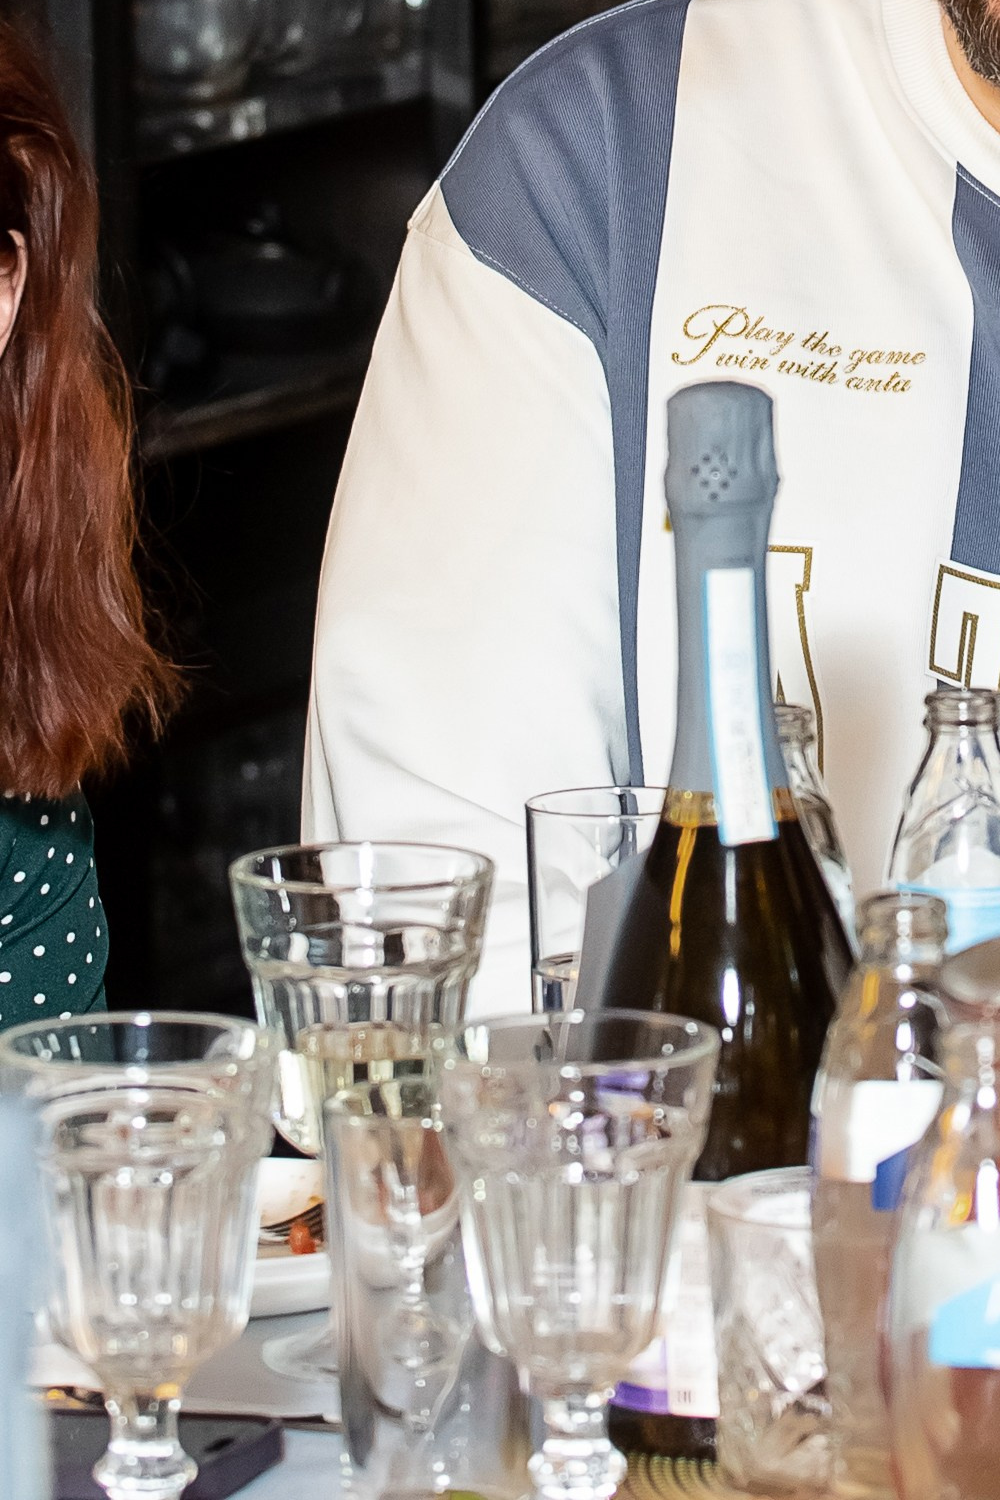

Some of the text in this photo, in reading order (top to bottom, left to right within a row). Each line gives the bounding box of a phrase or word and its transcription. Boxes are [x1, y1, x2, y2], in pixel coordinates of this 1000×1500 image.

[671, 304, 928, 374] Play the game
[715, 349, 912, 394] win with anta
